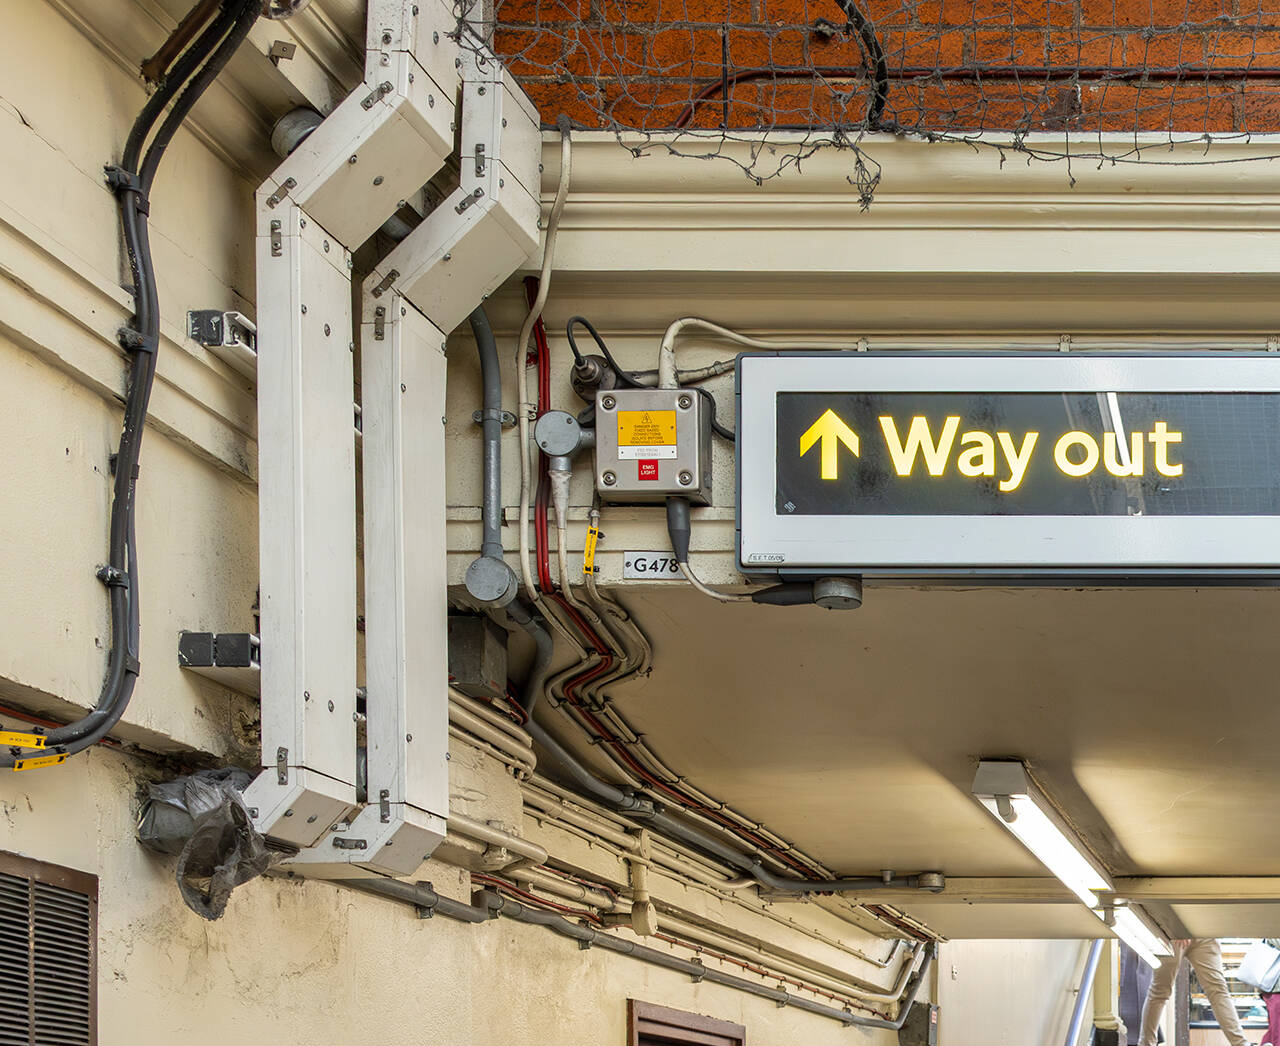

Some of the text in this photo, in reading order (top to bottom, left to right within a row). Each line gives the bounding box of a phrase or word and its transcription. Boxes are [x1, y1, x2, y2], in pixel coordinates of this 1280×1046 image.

[878, 415, 1183, 492] Way out
[634, 557, 679, 572] G478
